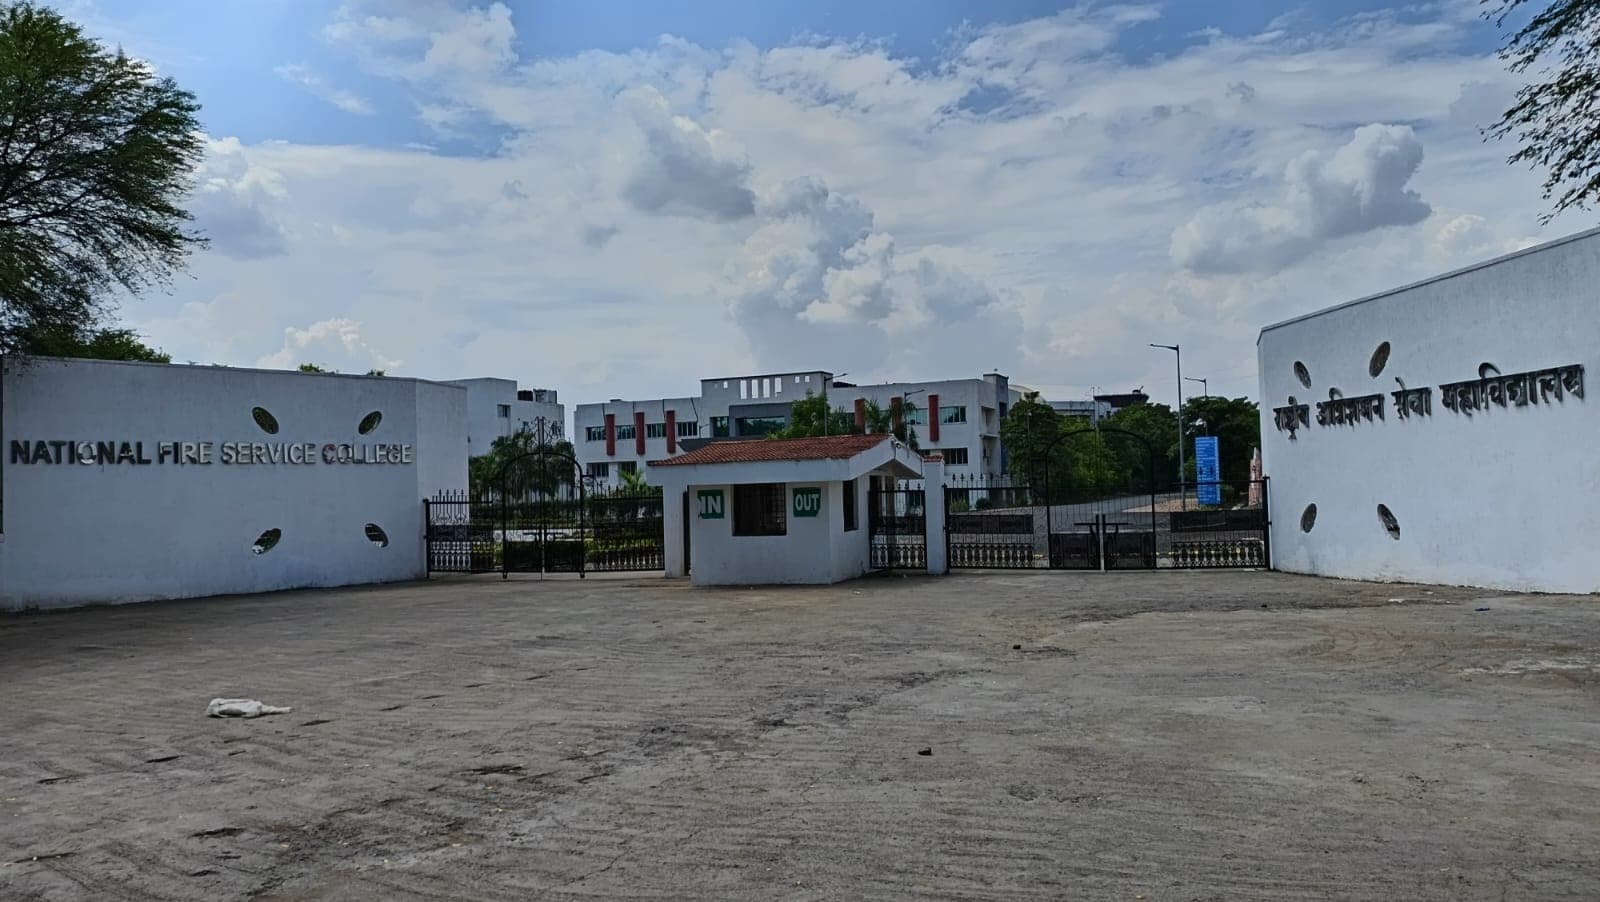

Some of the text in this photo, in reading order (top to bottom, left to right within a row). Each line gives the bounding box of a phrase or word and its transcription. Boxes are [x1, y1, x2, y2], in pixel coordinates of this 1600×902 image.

[1391, 377, 1432, 420] सेवा
[1439, 362, 1585, 416] महाविद्यालय
[11, 440, 412, 465] NATIONAL FIRE SERVICE COLLEGE
[701, 495, 721, 514] IN
[795, 493, 819, 511] OUT
